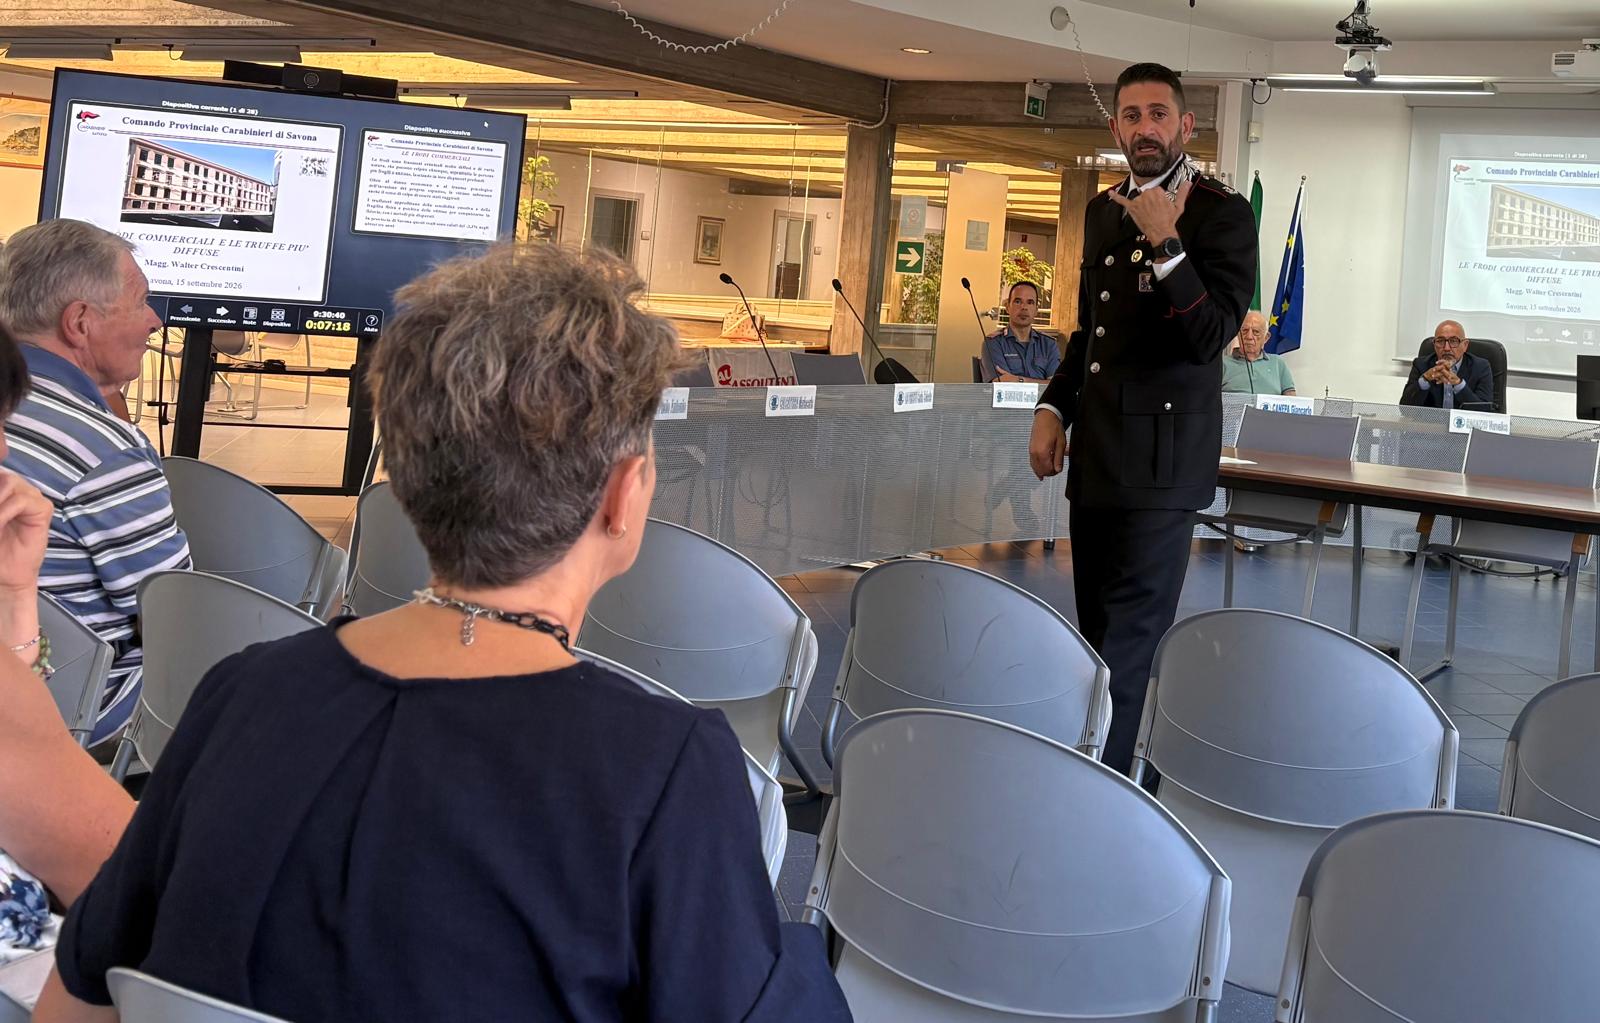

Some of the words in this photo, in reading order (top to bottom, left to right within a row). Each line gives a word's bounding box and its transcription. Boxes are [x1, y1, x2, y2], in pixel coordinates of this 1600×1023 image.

[122, 116, 165, 128] Comando
[168, 120, 219, 132] Provinciale
[221, 125, 273, 138] Carabinieri
[275, 130, 284, 139] di
[286, 131, 317, 141] Savona
[1485, 166, 1518, 176] Comando
[1519, 168, 1558, 178] Provinciale
[1559, 169, 1600, 179] Carabinieri
[138, 233, 215, 246] COMMERCIALI
[219, 238, 227, 247] E
[228, 239, 243, 248] LE
[245, 240, 286, 251] TRUFFE
[173, 246, 220, 257] DIFFUSE
[144, 258, 169, 268] Magg.
[171, 260, 199, 270] Walter
[200, 262, 244, 272] Crescentini
[1458, 261, 1470, 270] LE
[1472, 262, 1498, 272] FRODI
[1499, 264, 1559, 275] COMMERCIALI
[1568, 268, 1580, 276] LE
[149, 278, 174, 287] avona,
[176, 278, 185, 286] 15
[186, 279, 223, 288] settembre
[224, 281, 243, 290] 2026
[1526, 276, 1563, 285] DIFFUSE
[305, 319, 351, 332] 0:07:18
